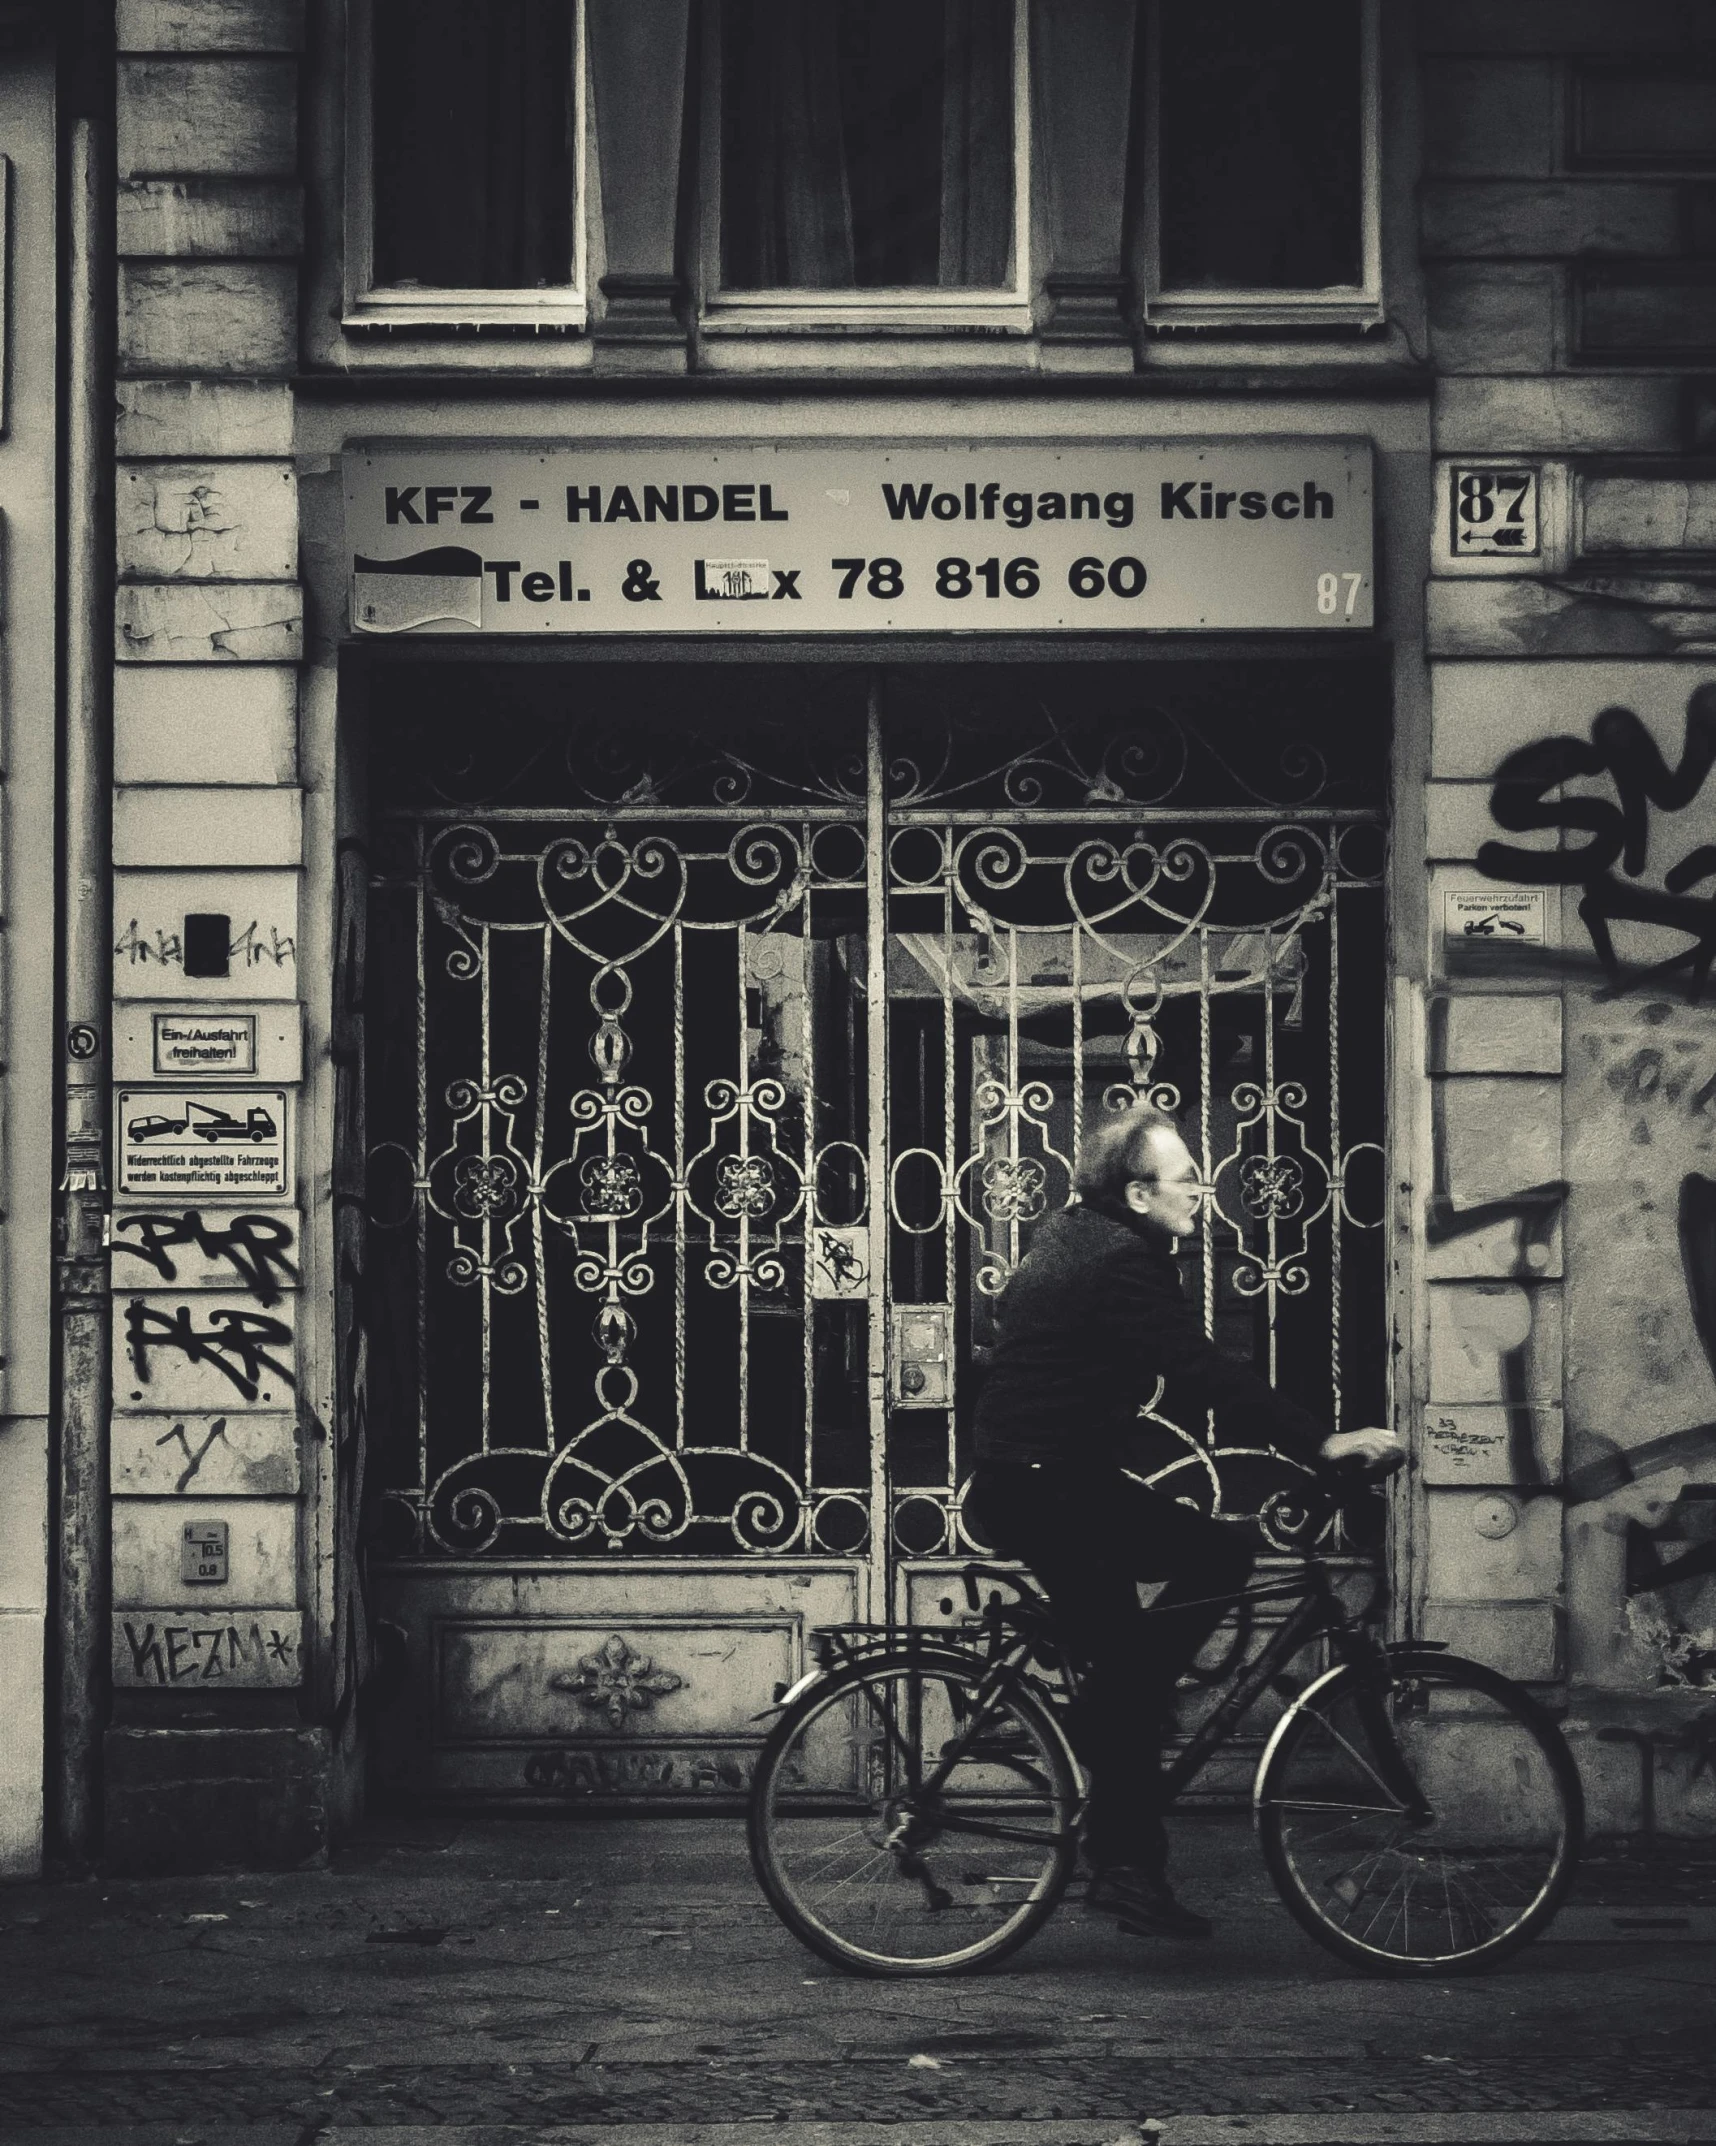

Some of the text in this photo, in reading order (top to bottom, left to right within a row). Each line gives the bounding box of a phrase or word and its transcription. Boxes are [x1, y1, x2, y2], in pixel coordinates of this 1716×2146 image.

[384, 485, 494, 525] KFZ
[566, 483, 789, 523] HANDEL
[881, 482, 1134, 529] Wolfgang
[1161, 480, 1334, 521] Kirsch
[1459, 474, 1531, 524] 87
[483, 560, 591, 603] Tel.
[621, 559, 664, 602] &
[831, 559, 904, 600] 78
[935, 558, 1040, 600] 816
[1068, 558, 1147, 600] 60
[1317, 572, 1361, 615] 87
[1450, 893, 1538, 902] Feuerwehrzufahrt
[173, 1046, 237, 1059] freihalten!
[127, 1154, 279, 1169] Widerrechtlich abgestellte Fahrzeuge
[127, 1171, 280, 1184] werden kostenpflichtig abgeschleppt
